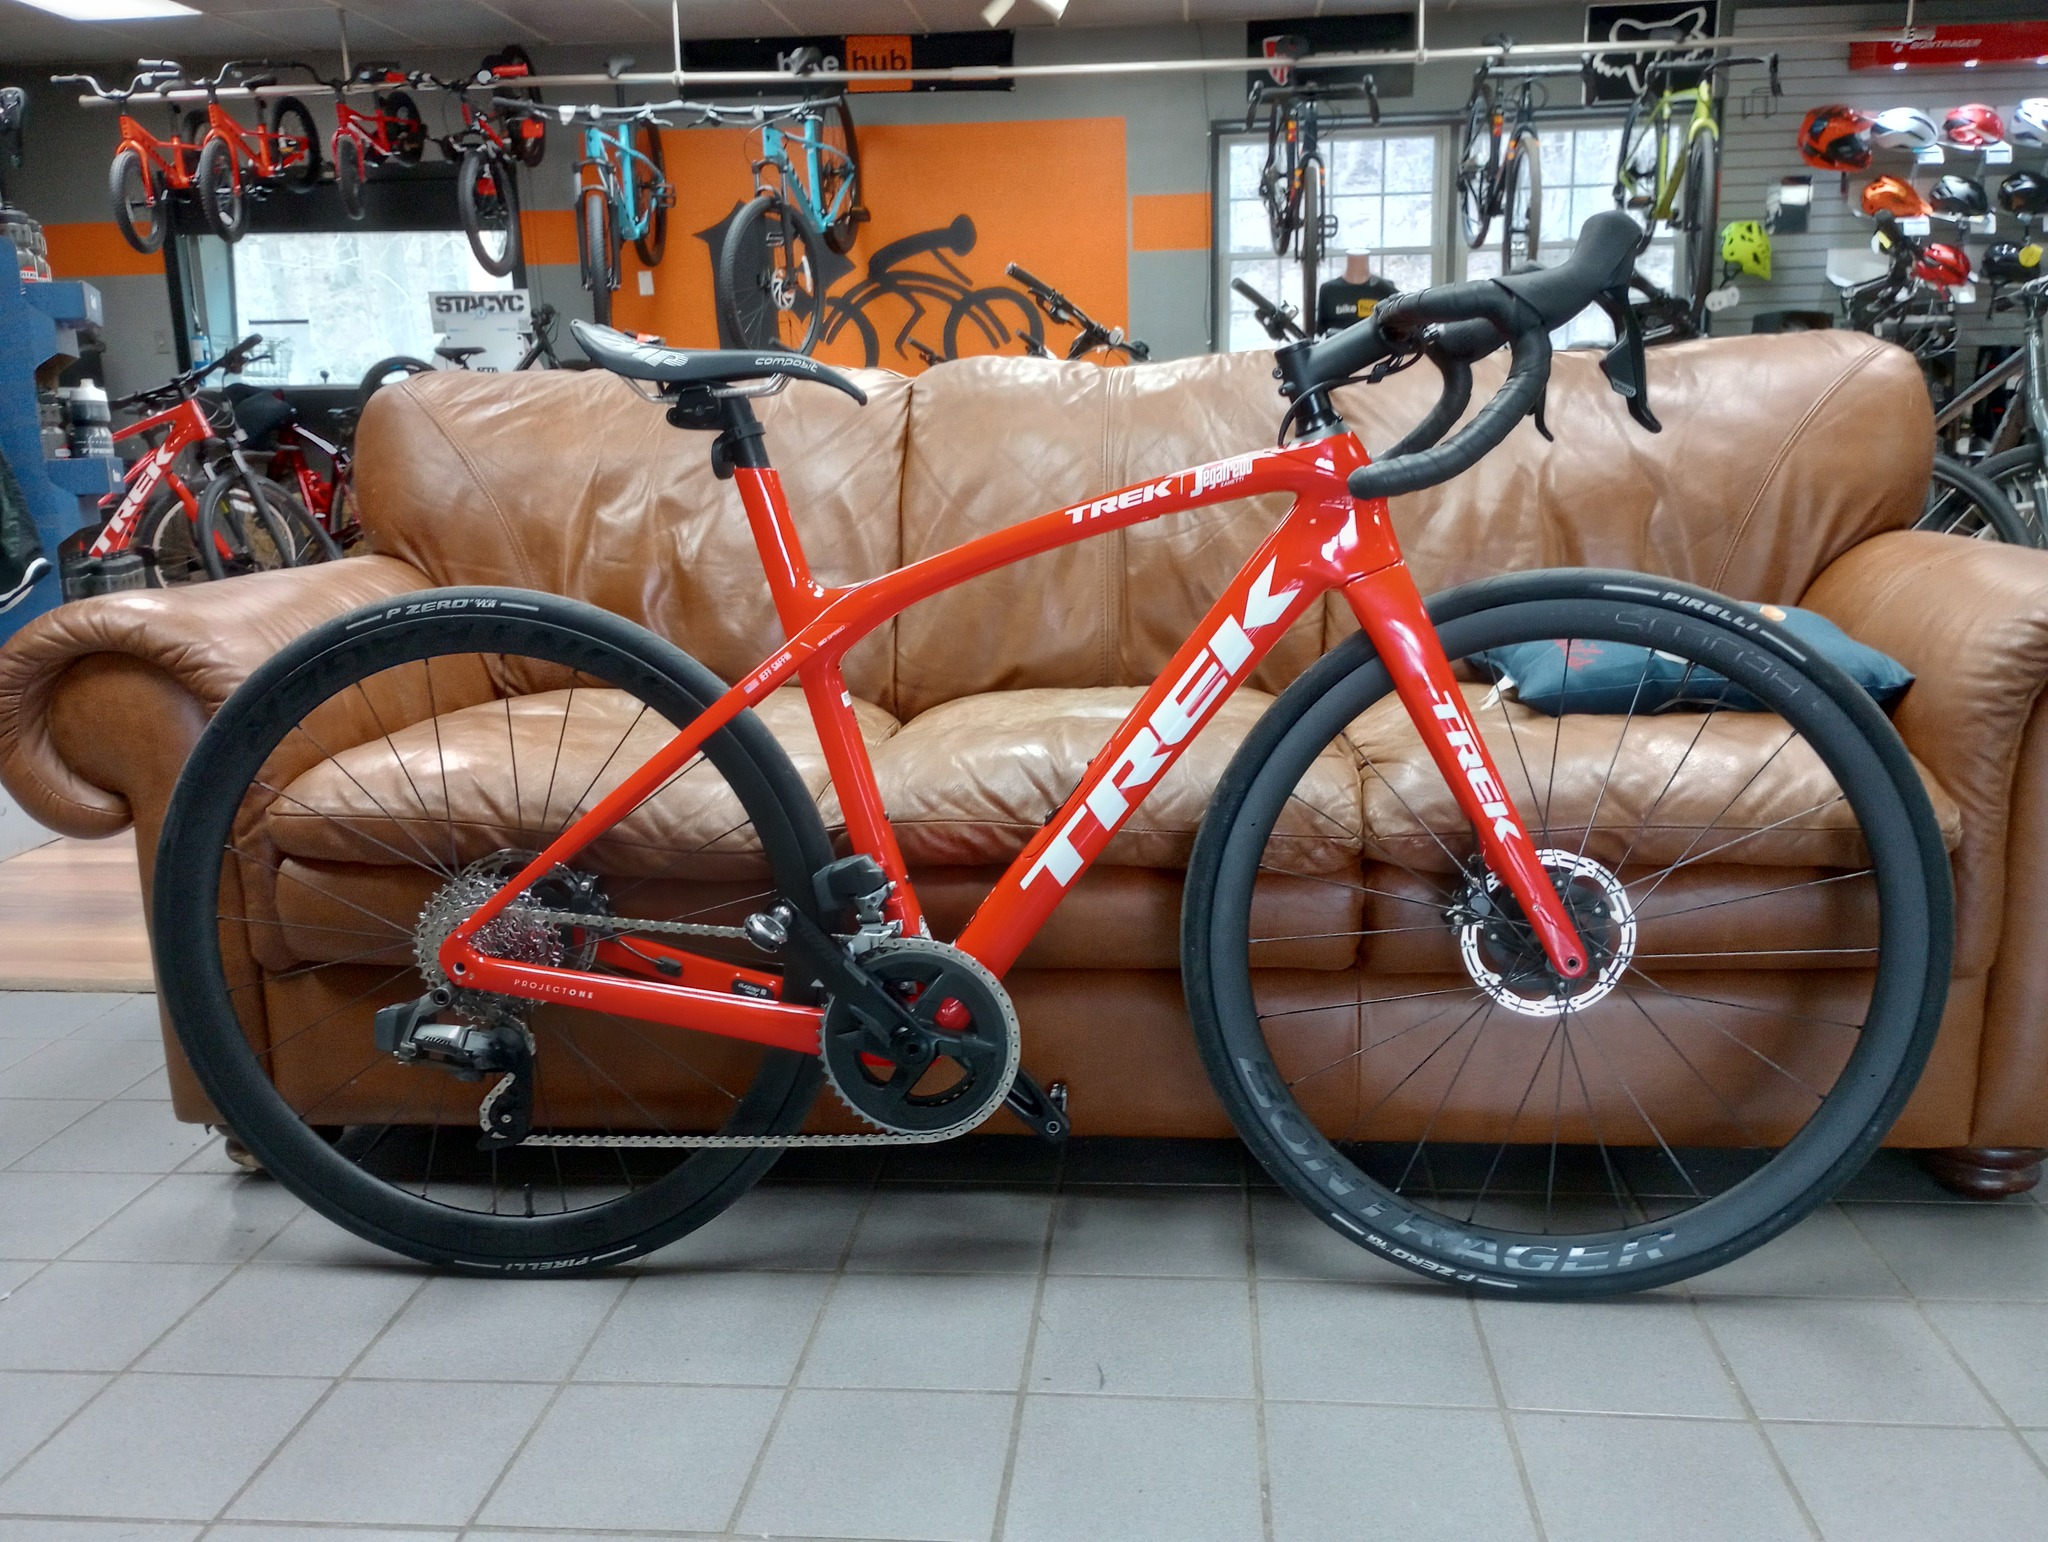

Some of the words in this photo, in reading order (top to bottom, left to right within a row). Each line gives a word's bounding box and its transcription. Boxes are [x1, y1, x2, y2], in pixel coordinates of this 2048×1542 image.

[853, 49, 907, 71] hub
[435, 294, 525, 313] STACYC
[89, 443, 174, 556] TREK
[1065, 478, 1172, 524] TREK
[386, 607, 402, 619] P
[406, 599, 469, 615] ZERO
[1661, 591, 1759, 631] PIRELLI
[1019, 554, 1301, 890] TREK
[1432, 690, 1522, 843] TREK
[514, 979, 594, 999] PROJECTONE
[1238, 1057, 1677, 1273] BONTRAGER
[505, 1256, 589, 1271] PIRELLI
[1390, 1248, 1456, 1276] ZERO
[1457, 1273, 1476, 1282] P
